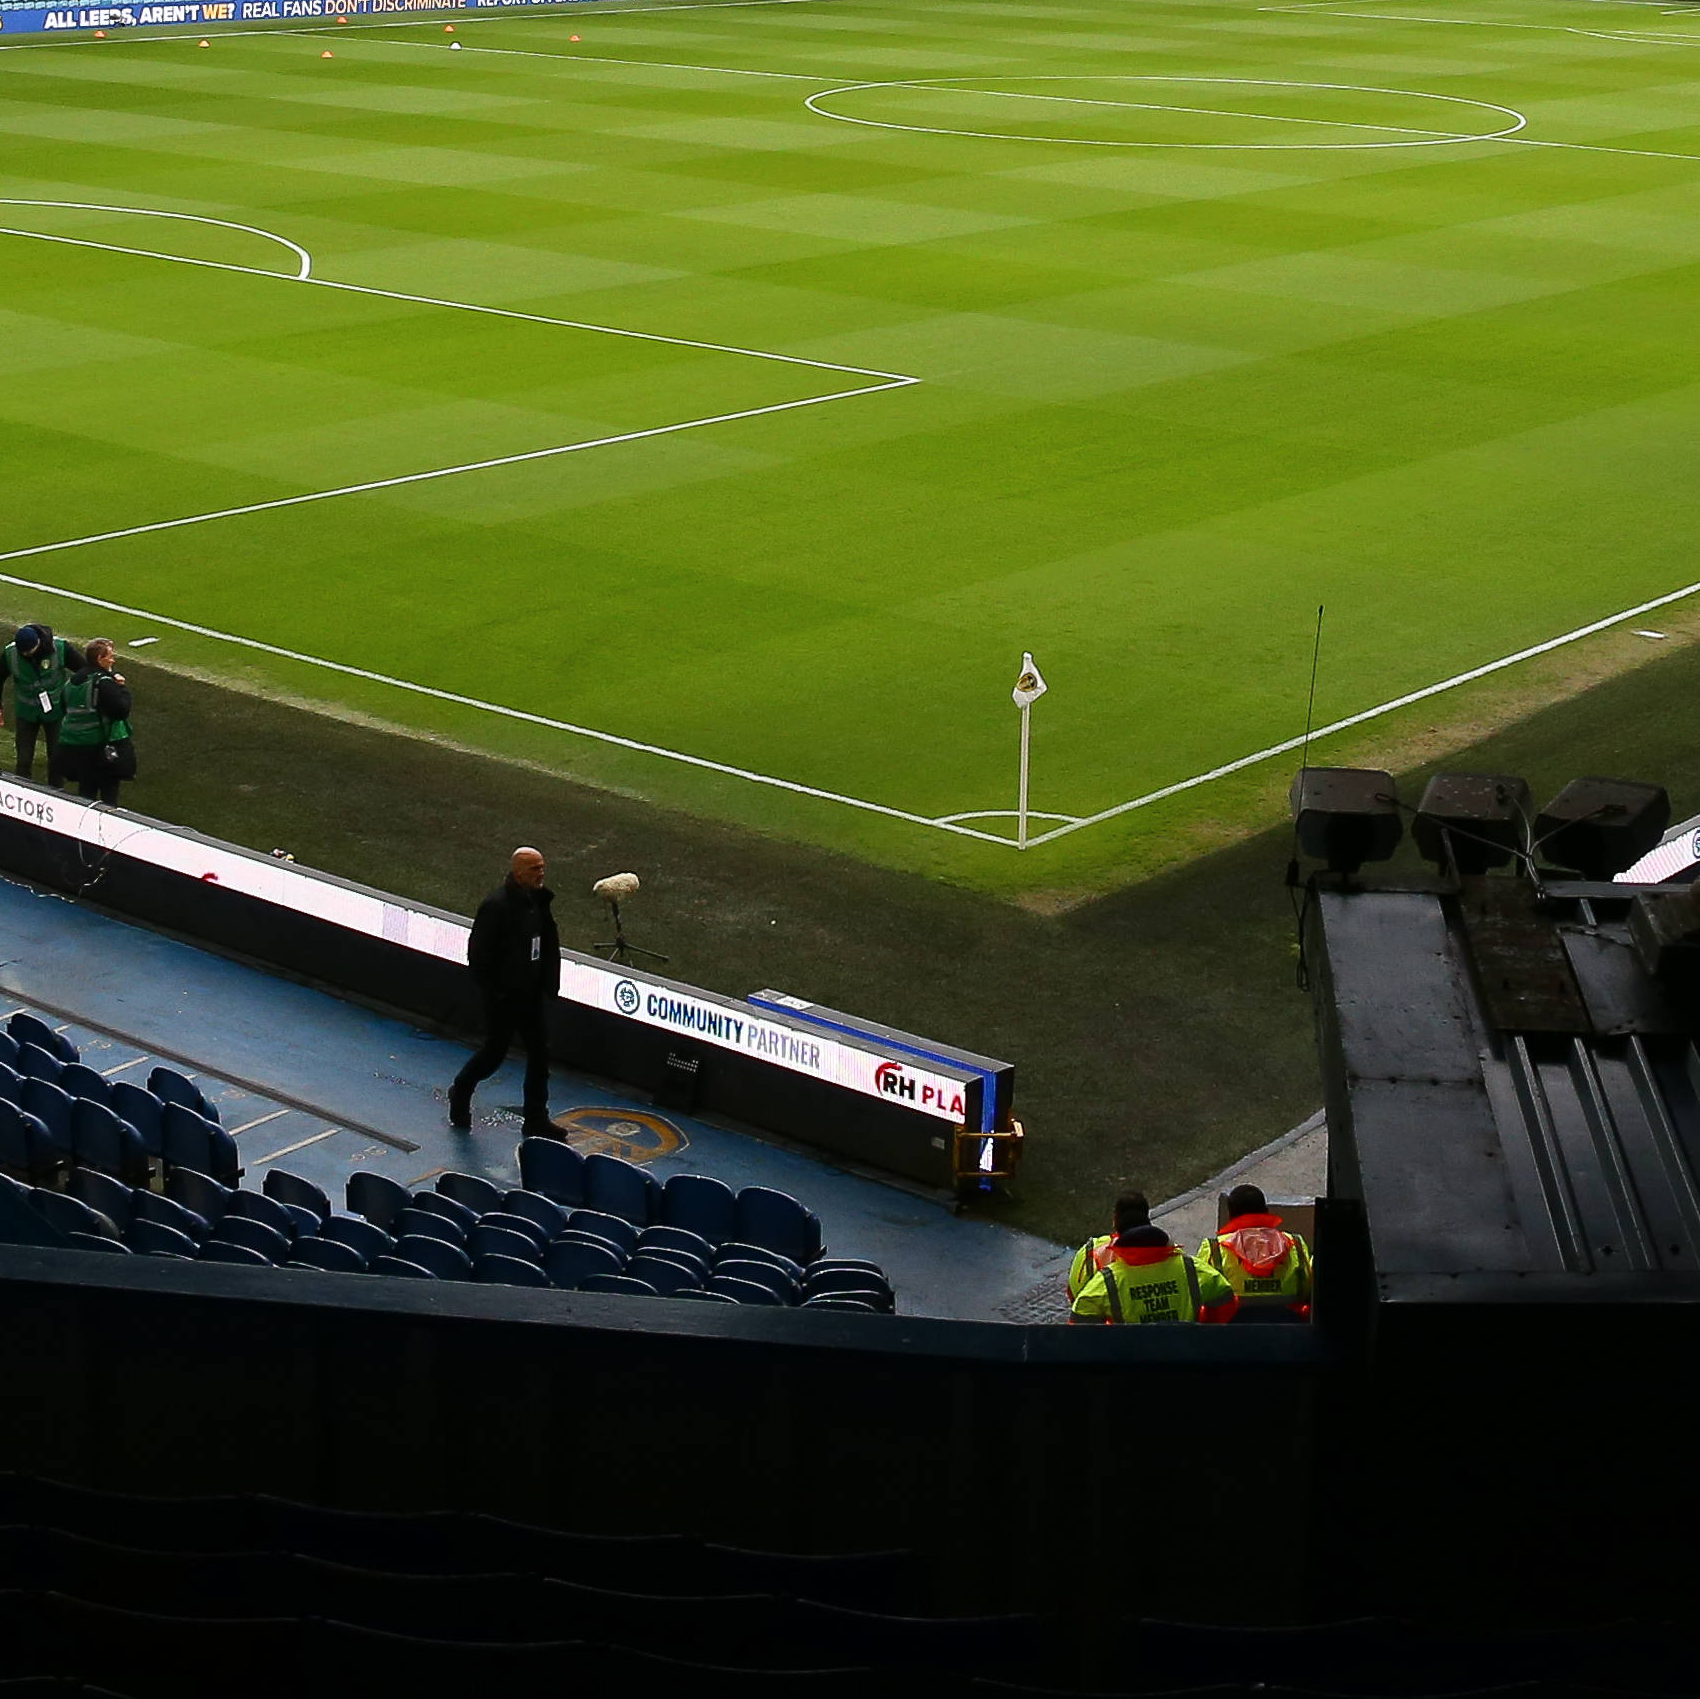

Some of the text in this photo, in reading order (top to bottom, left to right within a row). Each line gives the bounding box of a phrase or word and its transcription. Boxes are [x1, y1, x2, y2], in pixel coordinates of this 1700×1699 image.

[45, 3, 235, 29] ALL AREN'T WE?
[242, 2, 280, 18] REAL
[283, 0, 321, 17] FANS
[647, 993, 820, 1069] COMMUNITY PARTNER
[879, 1068, 965, 1117] RH PLA
[1130, 1280, 1178, 1300] RESPONSE
[1143, 1296, 1170, 1311] TEAM
